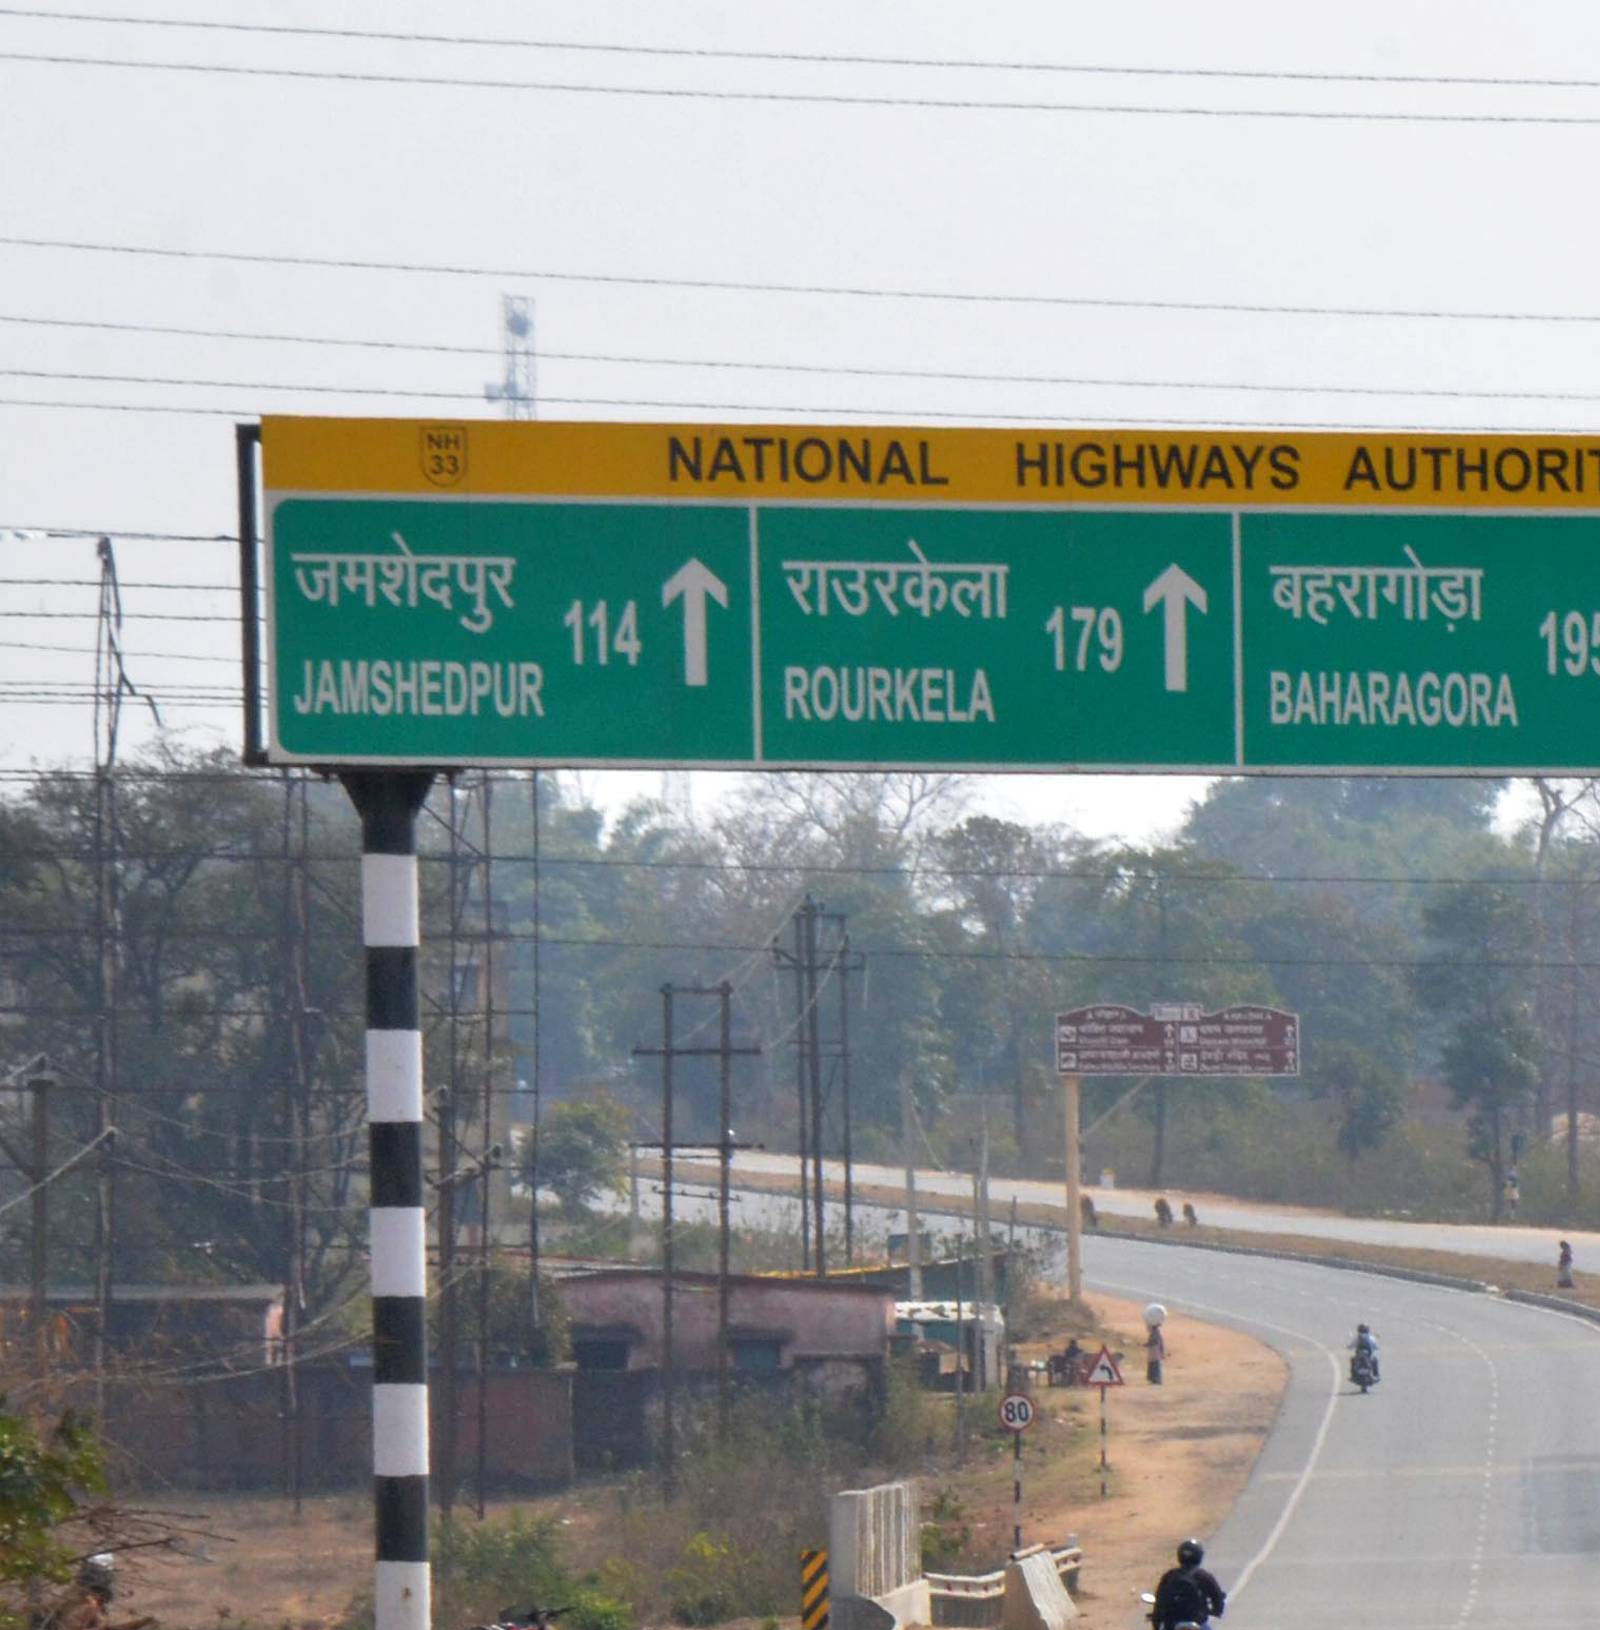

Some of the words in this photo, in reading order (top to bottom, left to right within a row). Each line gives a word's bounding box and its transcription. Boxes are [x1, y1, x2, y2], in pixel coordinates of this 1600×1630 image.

[427, 433, 460, 450] NH
[431, 454, 460, 475] 33
[667, 434, 950, 486] NATIONAL
[1014, 442, 1301, 491] HIGHWAYS
[291, 532, 517, 634] जमशेदपुर
[782, 539, 1010, 619] राउरकेला
[1269, 544, 1484, 633] बहरागोड़ा
[564, 599, 642, 666] 114
[1045, 606, 1124, 673] 179
[294, 659, 545, 718] JAMSHEDPUR
[784, 665, 996, 723] ROURKELA
[1270, 670, 1519, 727] BAHARAGORA
[1004, 1400, 1029, 1423] 80
